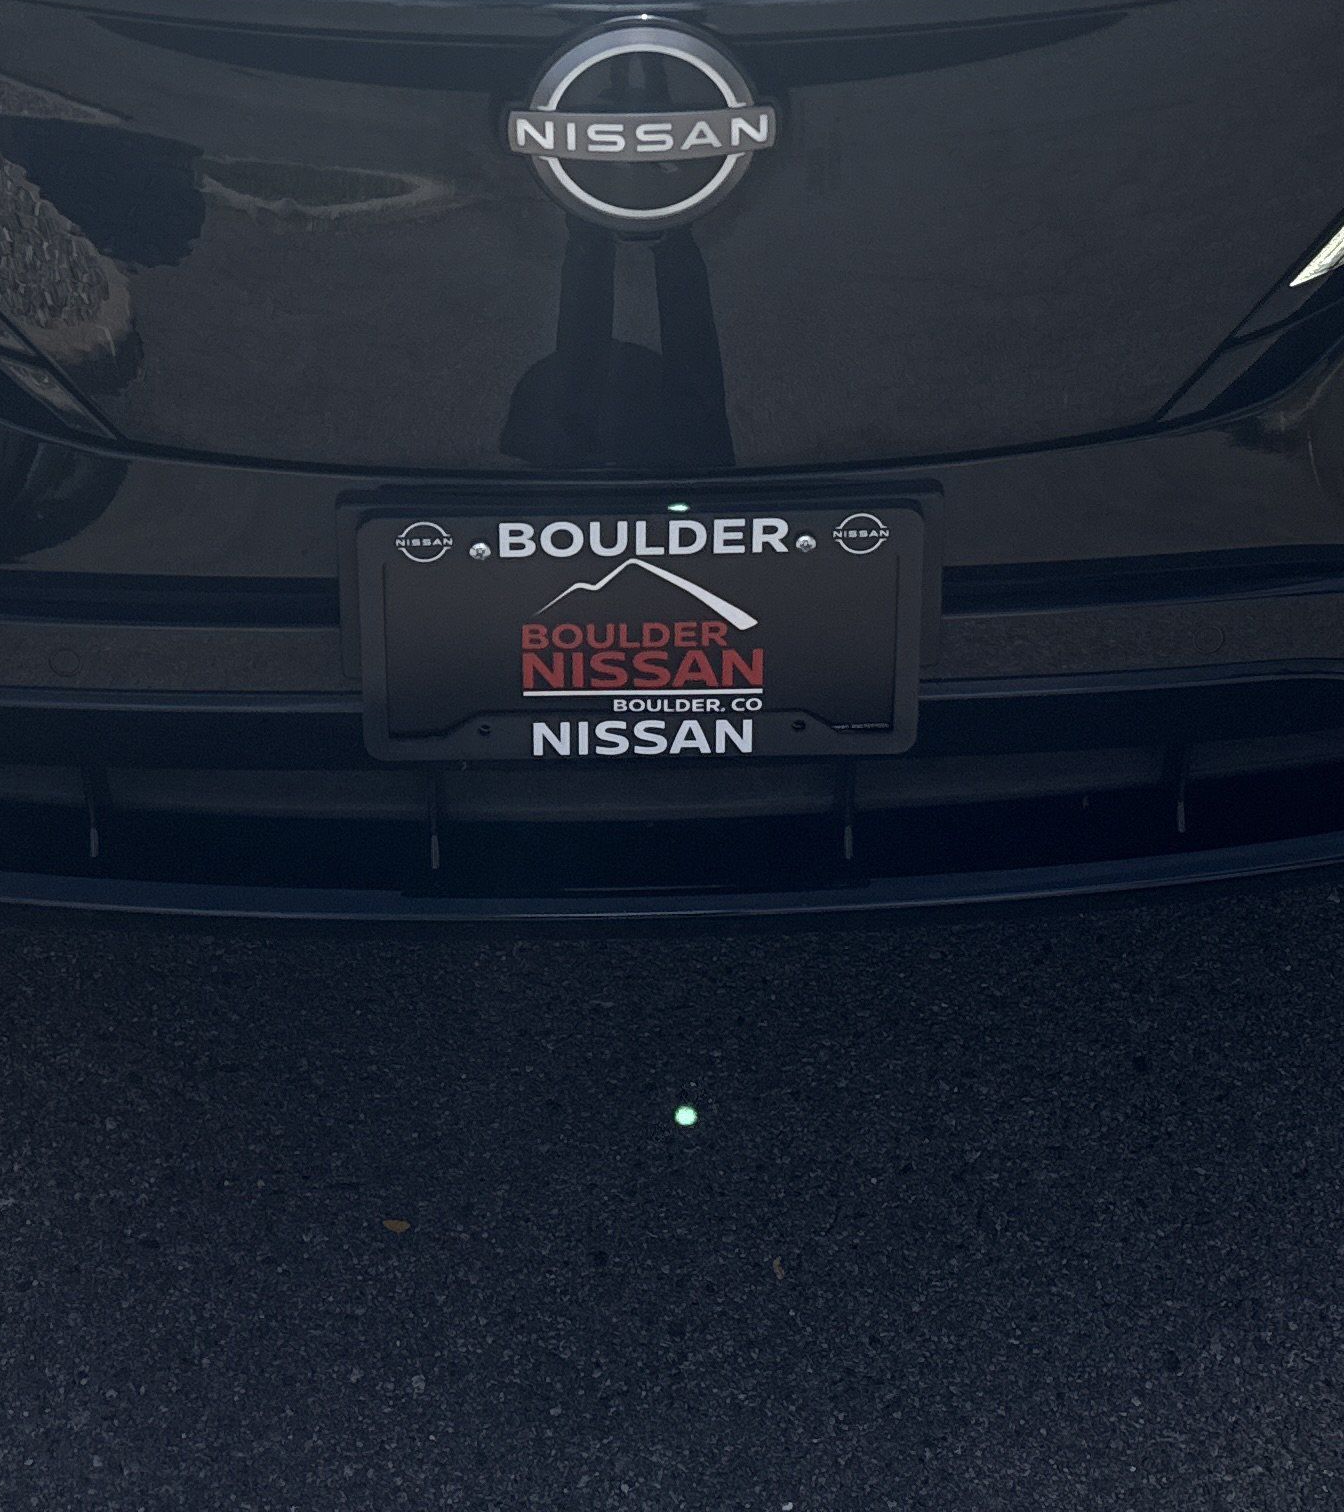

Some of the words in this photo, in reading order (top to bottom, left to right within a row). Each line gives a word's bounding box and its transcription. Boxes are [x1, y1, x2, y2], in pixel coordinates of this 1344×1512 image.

[516, 114, 768, 152] NISSAN
[396, 538, 453, 547] NISSAN
[498, 518, 789, 557] BOULDER
[833, 530, 889, 538] NISSAN
[522, 621, 728, 649] BOULDER
[522, 648, 763, 689] NISSAN
[731, 697, 762, 711] CO
[532, 719, 753, 756] NISSAN
